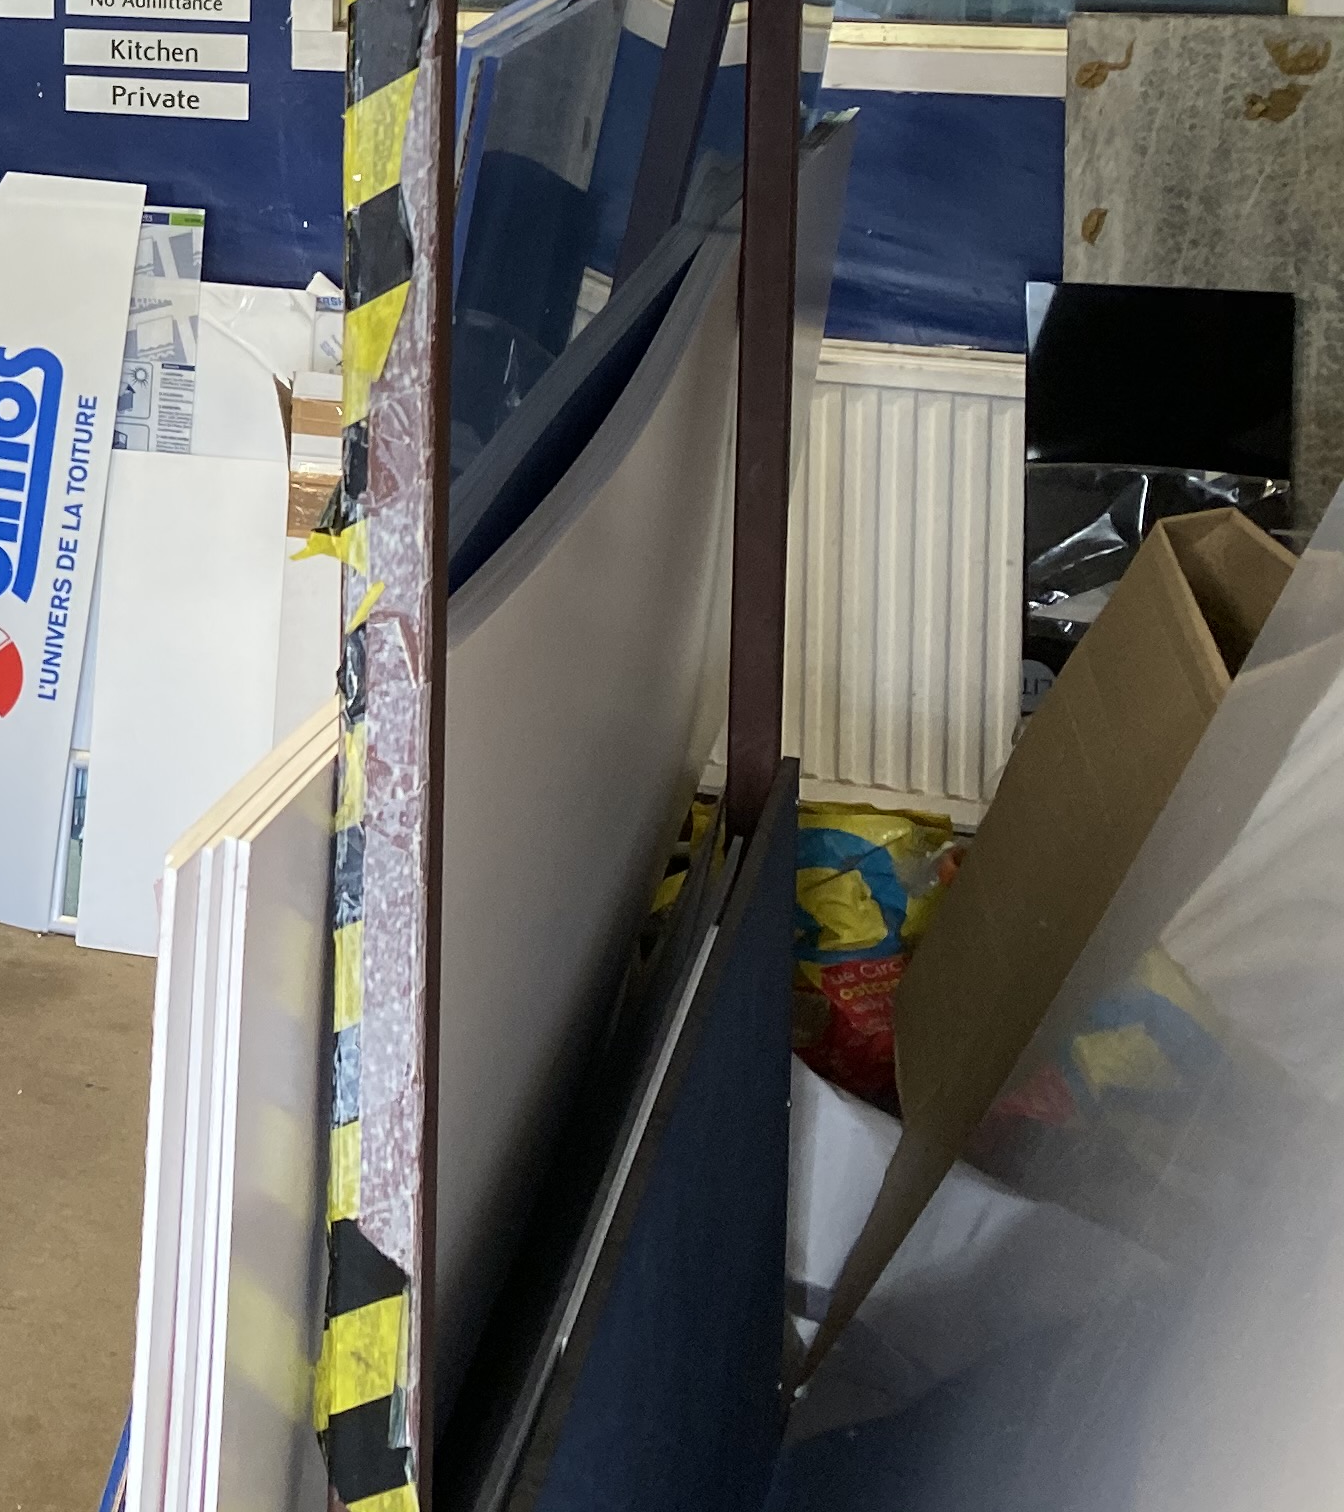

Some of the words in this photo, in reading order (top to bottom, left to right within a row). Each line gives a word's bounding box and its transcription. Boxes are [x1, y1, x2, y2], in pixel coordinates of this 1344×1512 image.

[111, 39, 199, 64] Kitchen
[111, 85, 201, 110] Private
[69, 393, 99, 495] TOITURE
[62, 498, 82, 533] LA
[57, 537, 76, 571] DE
[37, 576, 72, 702] L'UNIVERS
